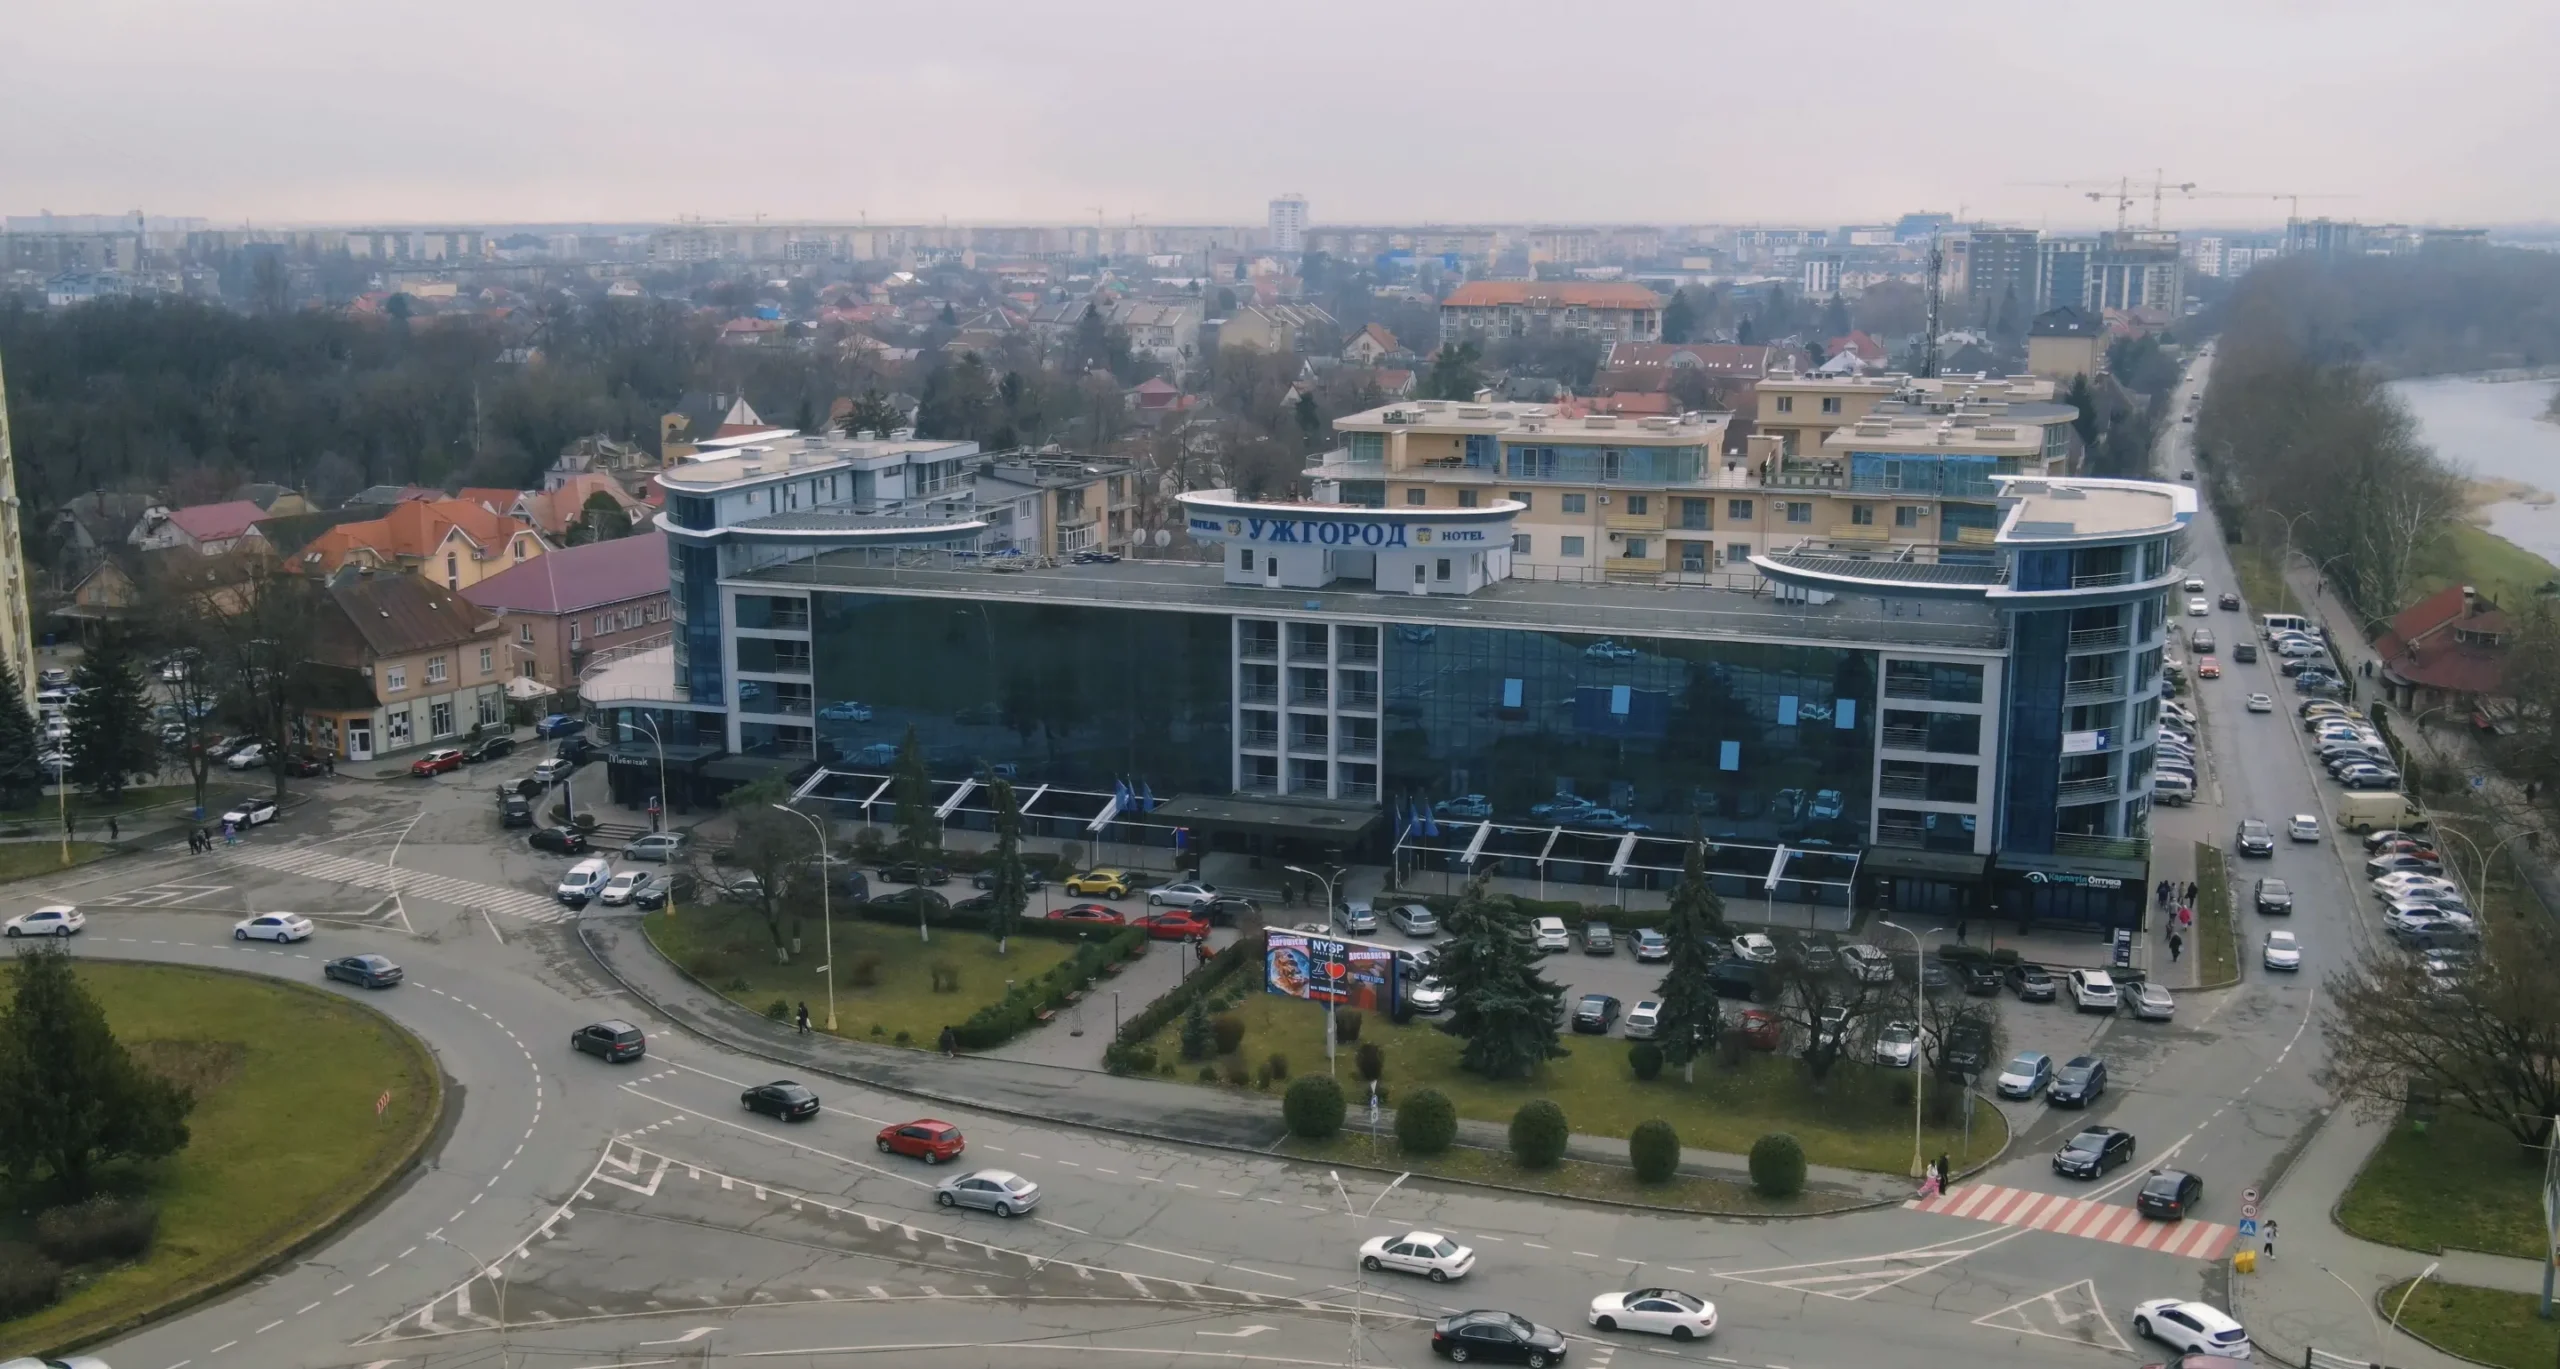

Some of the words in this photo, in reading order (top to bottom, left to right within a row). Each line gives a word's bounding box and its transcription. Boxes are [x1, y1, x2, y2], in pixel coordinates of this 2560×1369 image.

[1248, 518, 1407, 548] УЖГОРОД
[1441, 530, 1485, 541] HOTEL
[2088, 876, 2121, 886] Оптика
[1312, 940, 1344, 954] NYSP
